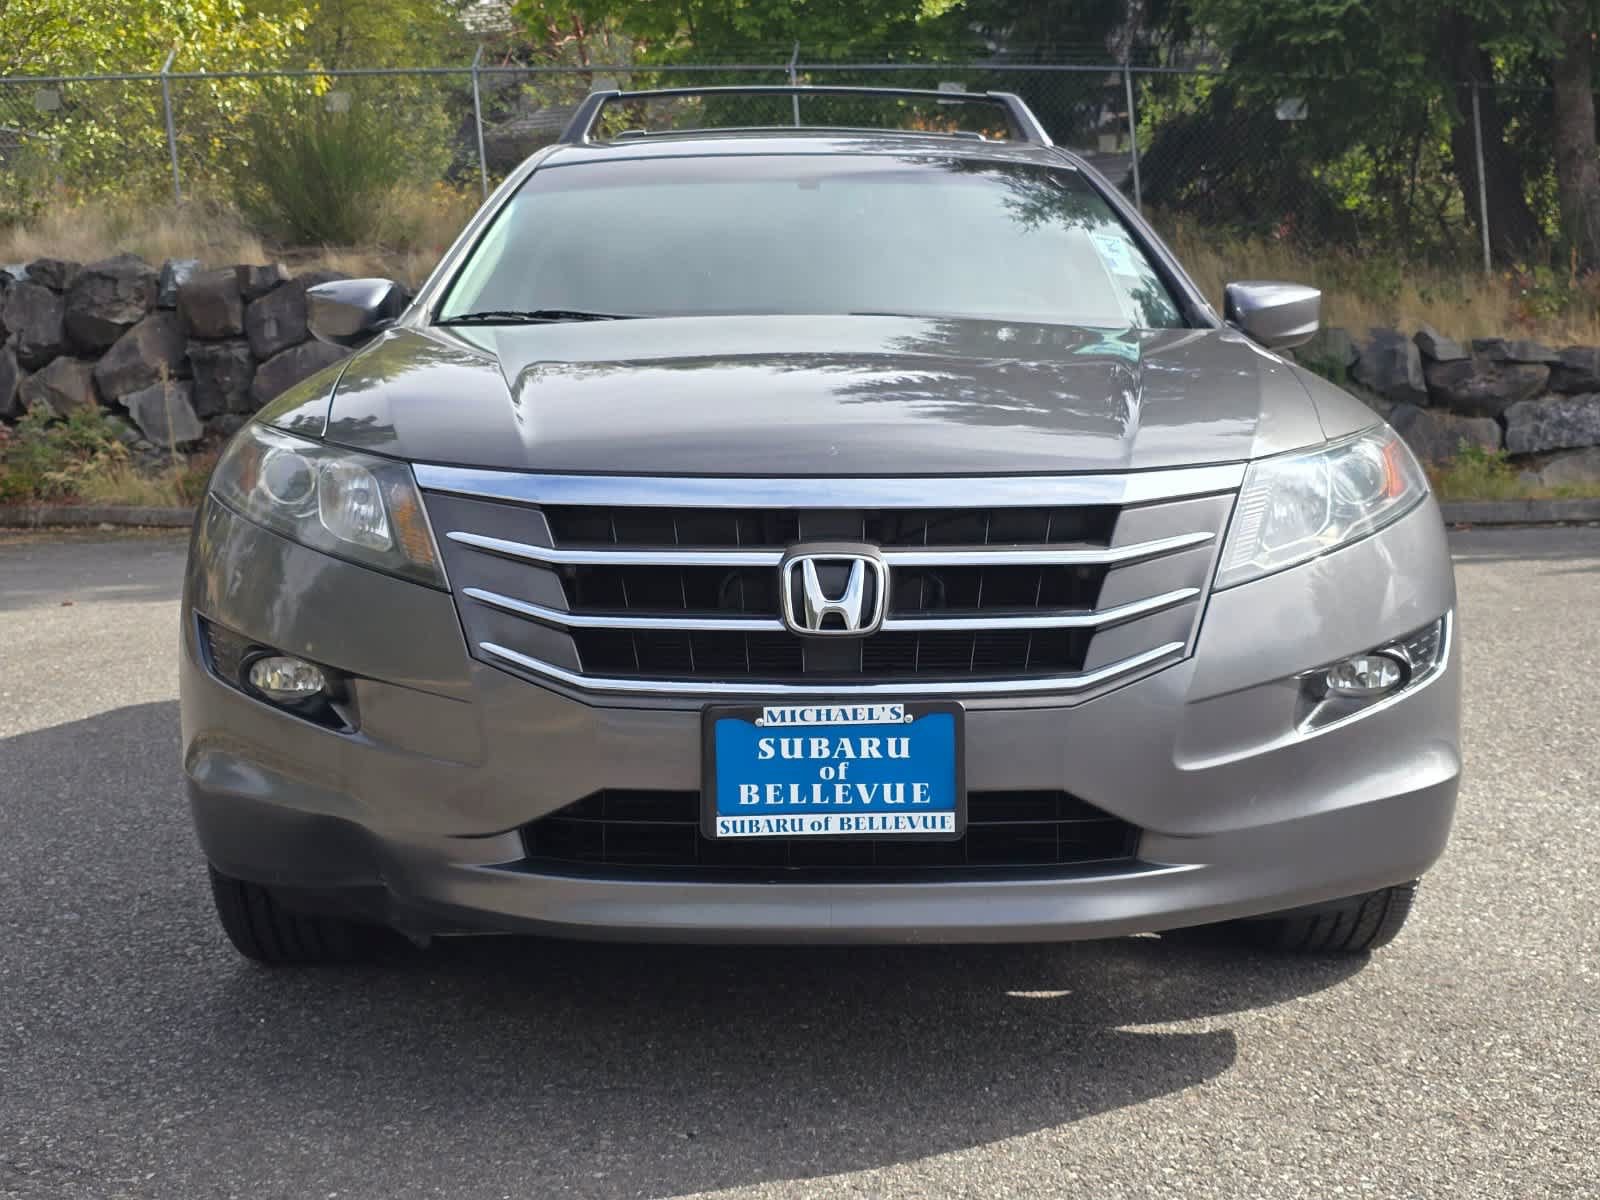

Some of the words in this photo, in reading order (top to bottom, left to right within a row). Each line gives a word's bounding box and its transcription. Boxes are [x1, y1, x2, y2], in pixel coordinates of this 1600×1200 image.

[766, 706, 903, 724] MICHAEL'S
[758, 737, 911, 760] SUBARU
[819, 762, 849, 780] of
[738, 782, 931, 805] BELLEVUE
[720, 817, 804, 835] SUBARU
[810, 816, 832, 832] of
[839, 815, 952, 832] BELLEVUE
